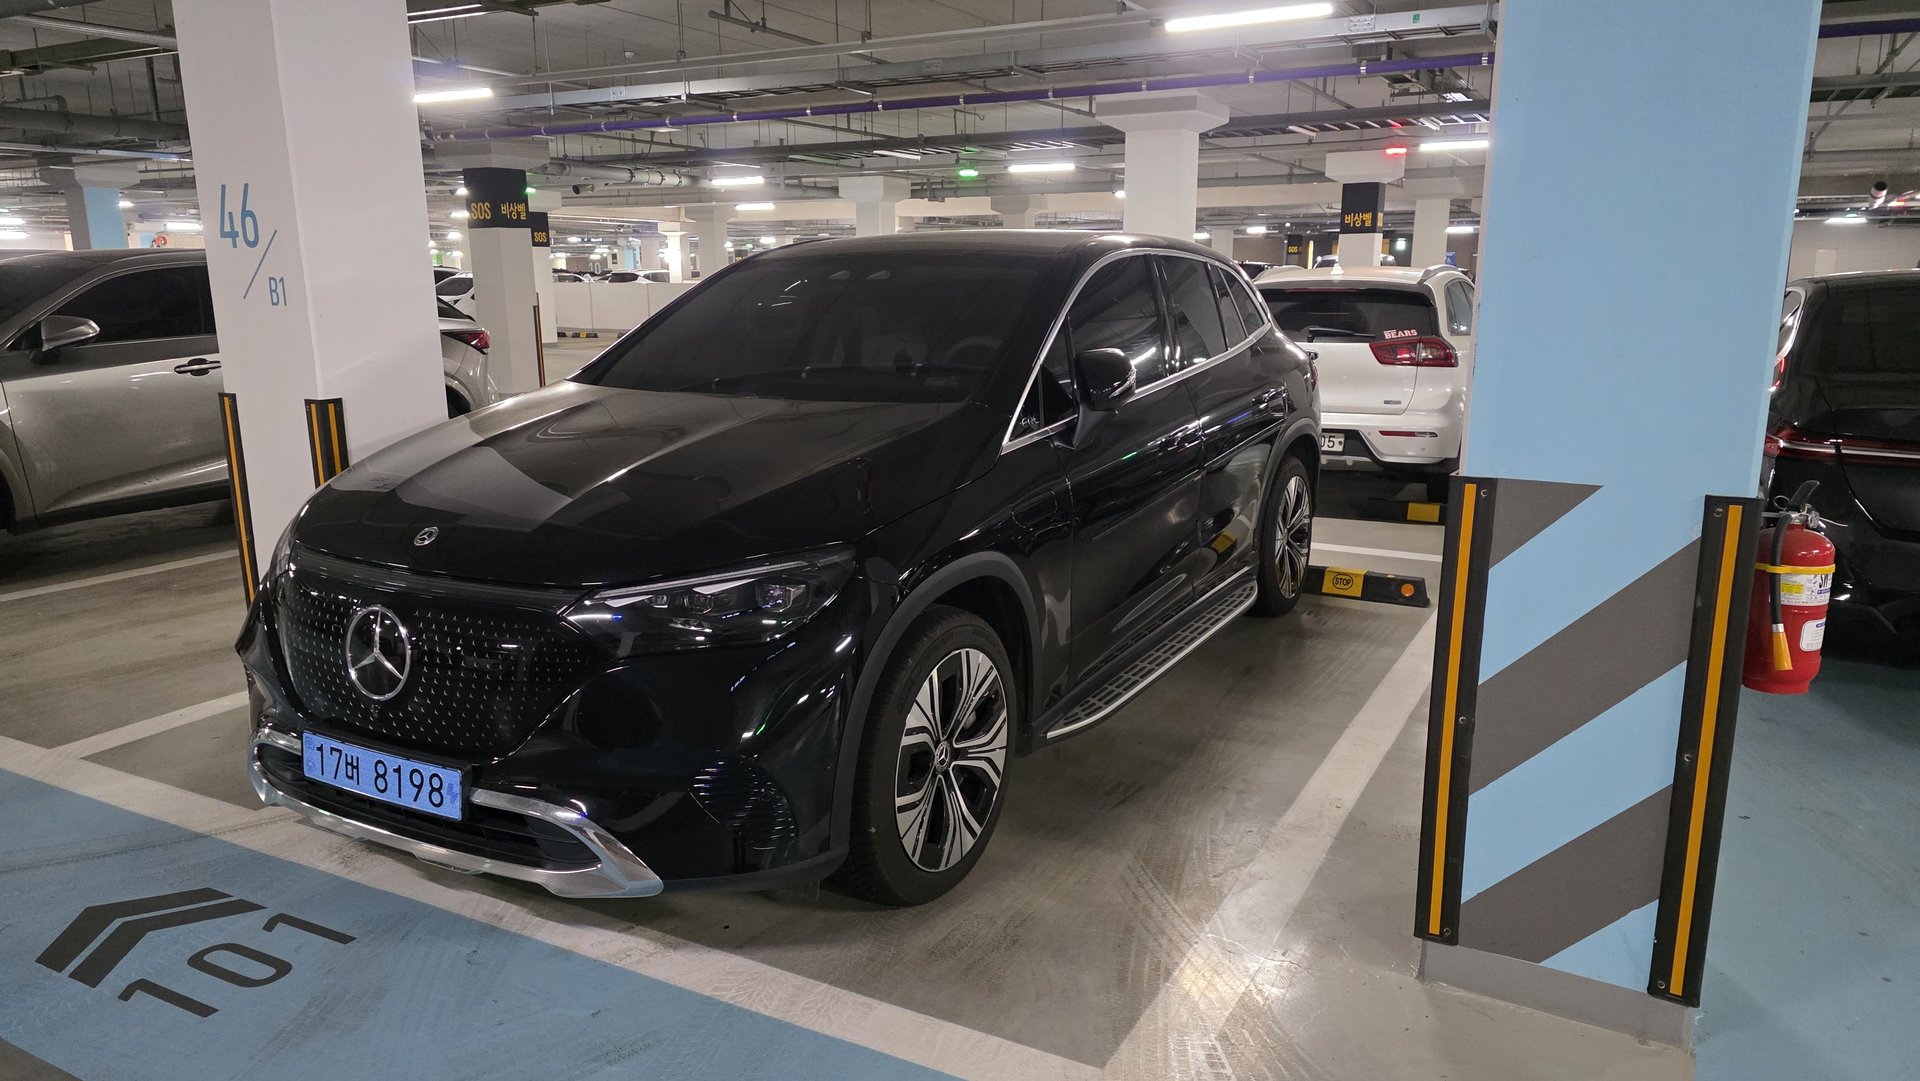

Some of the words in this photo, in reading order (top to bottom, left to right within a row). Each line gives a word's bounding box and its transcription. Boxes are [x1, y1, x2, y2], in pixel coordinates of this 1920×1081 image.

[220, 183, 259, 248] 46
[471, 202, 491, 219] SOS
[501, 202, 526, 220] 비상벨
[1344, 212, 1372, 227] 비상벨
[534, 232, 547, 242] SOS
[268, 276, 287, 307] B1
[1384, 329, 1418, 340] BEARS
[1334, 577, 1352, 586] STOP
[316, 743, 360, 786] 17버
[374, 759, 444, 808] 8198
[117, 912, 357, 1018] 101
